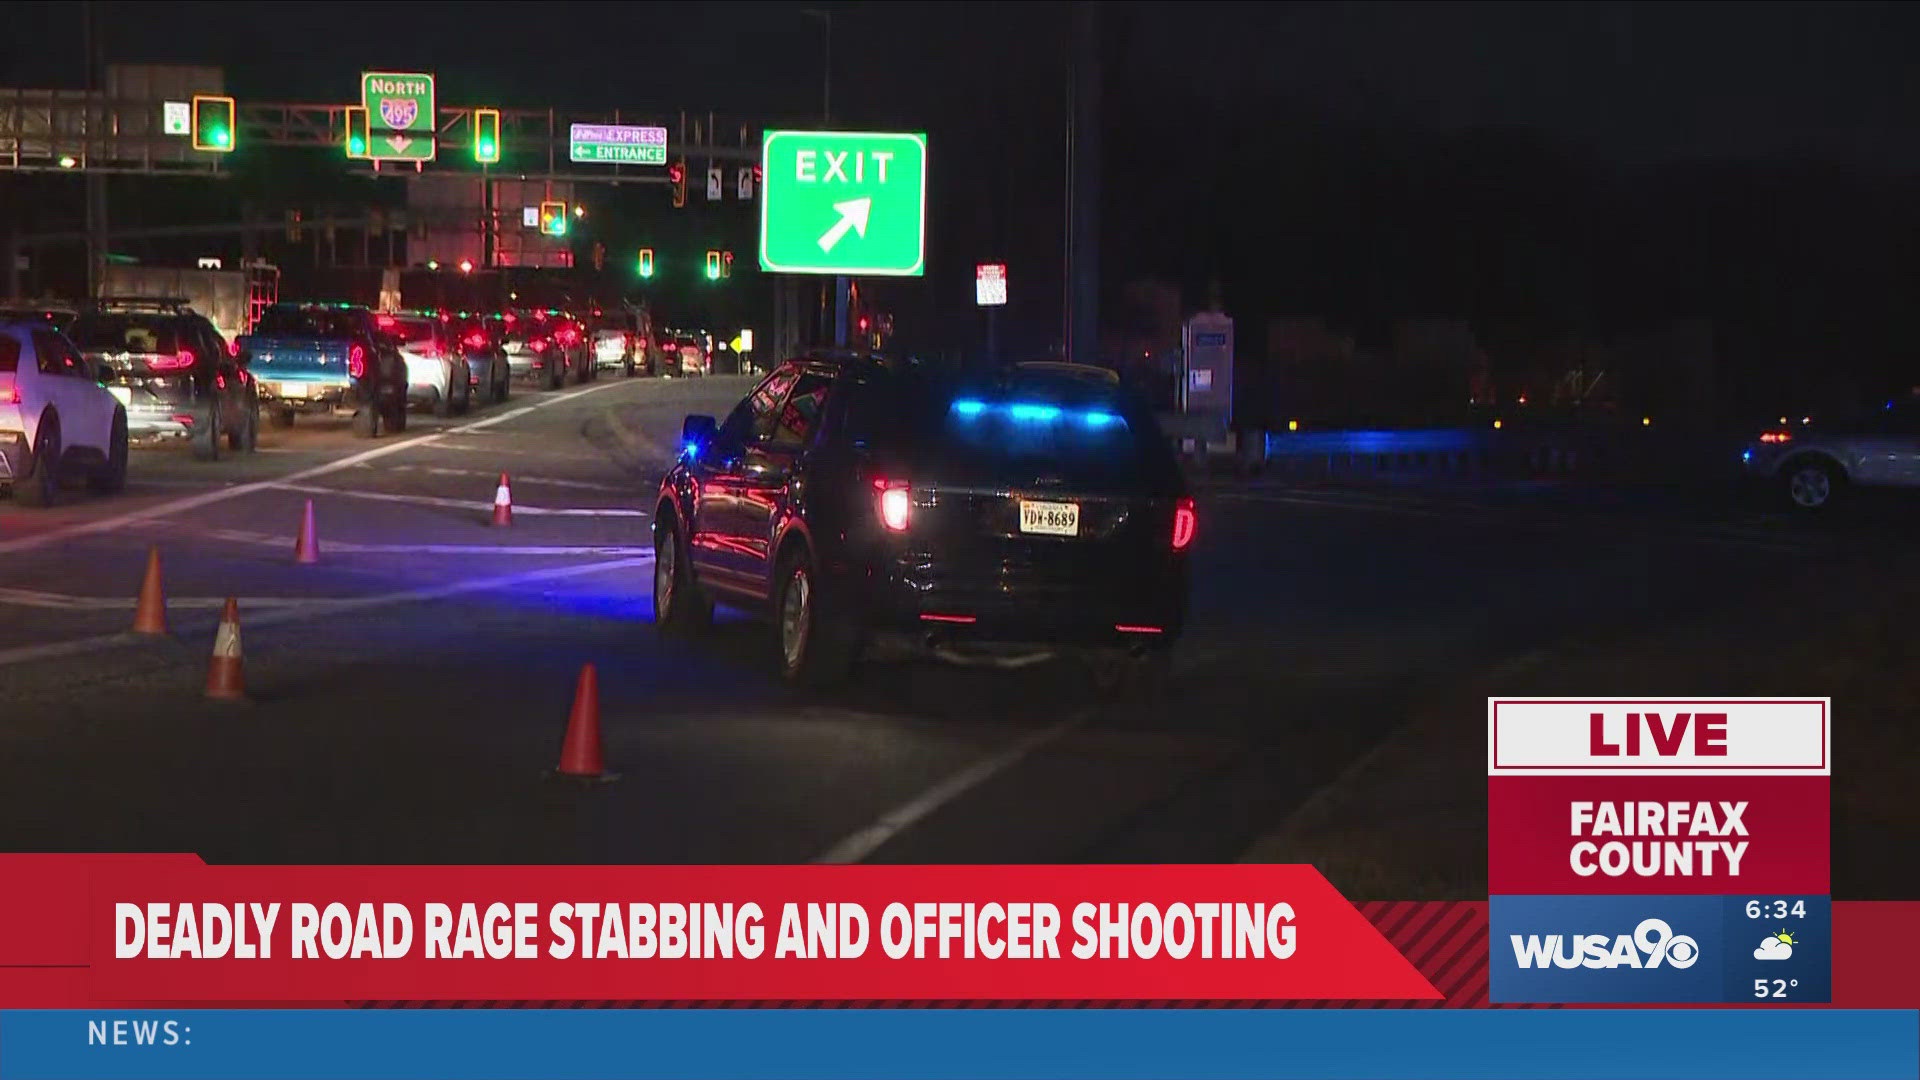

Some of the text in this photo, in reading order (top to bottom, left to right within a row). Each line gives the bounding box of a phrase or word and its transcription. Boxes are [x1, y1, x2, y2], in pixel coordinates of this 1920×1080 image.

[371, 79, 426, 95] NORTH
[386, 104, 413, 124] 495
[607, 129, 664, 144] EXPRESS
[596, 146, 664, 160] ENTRANCE
[796, 150, 894, 184] EXIT
